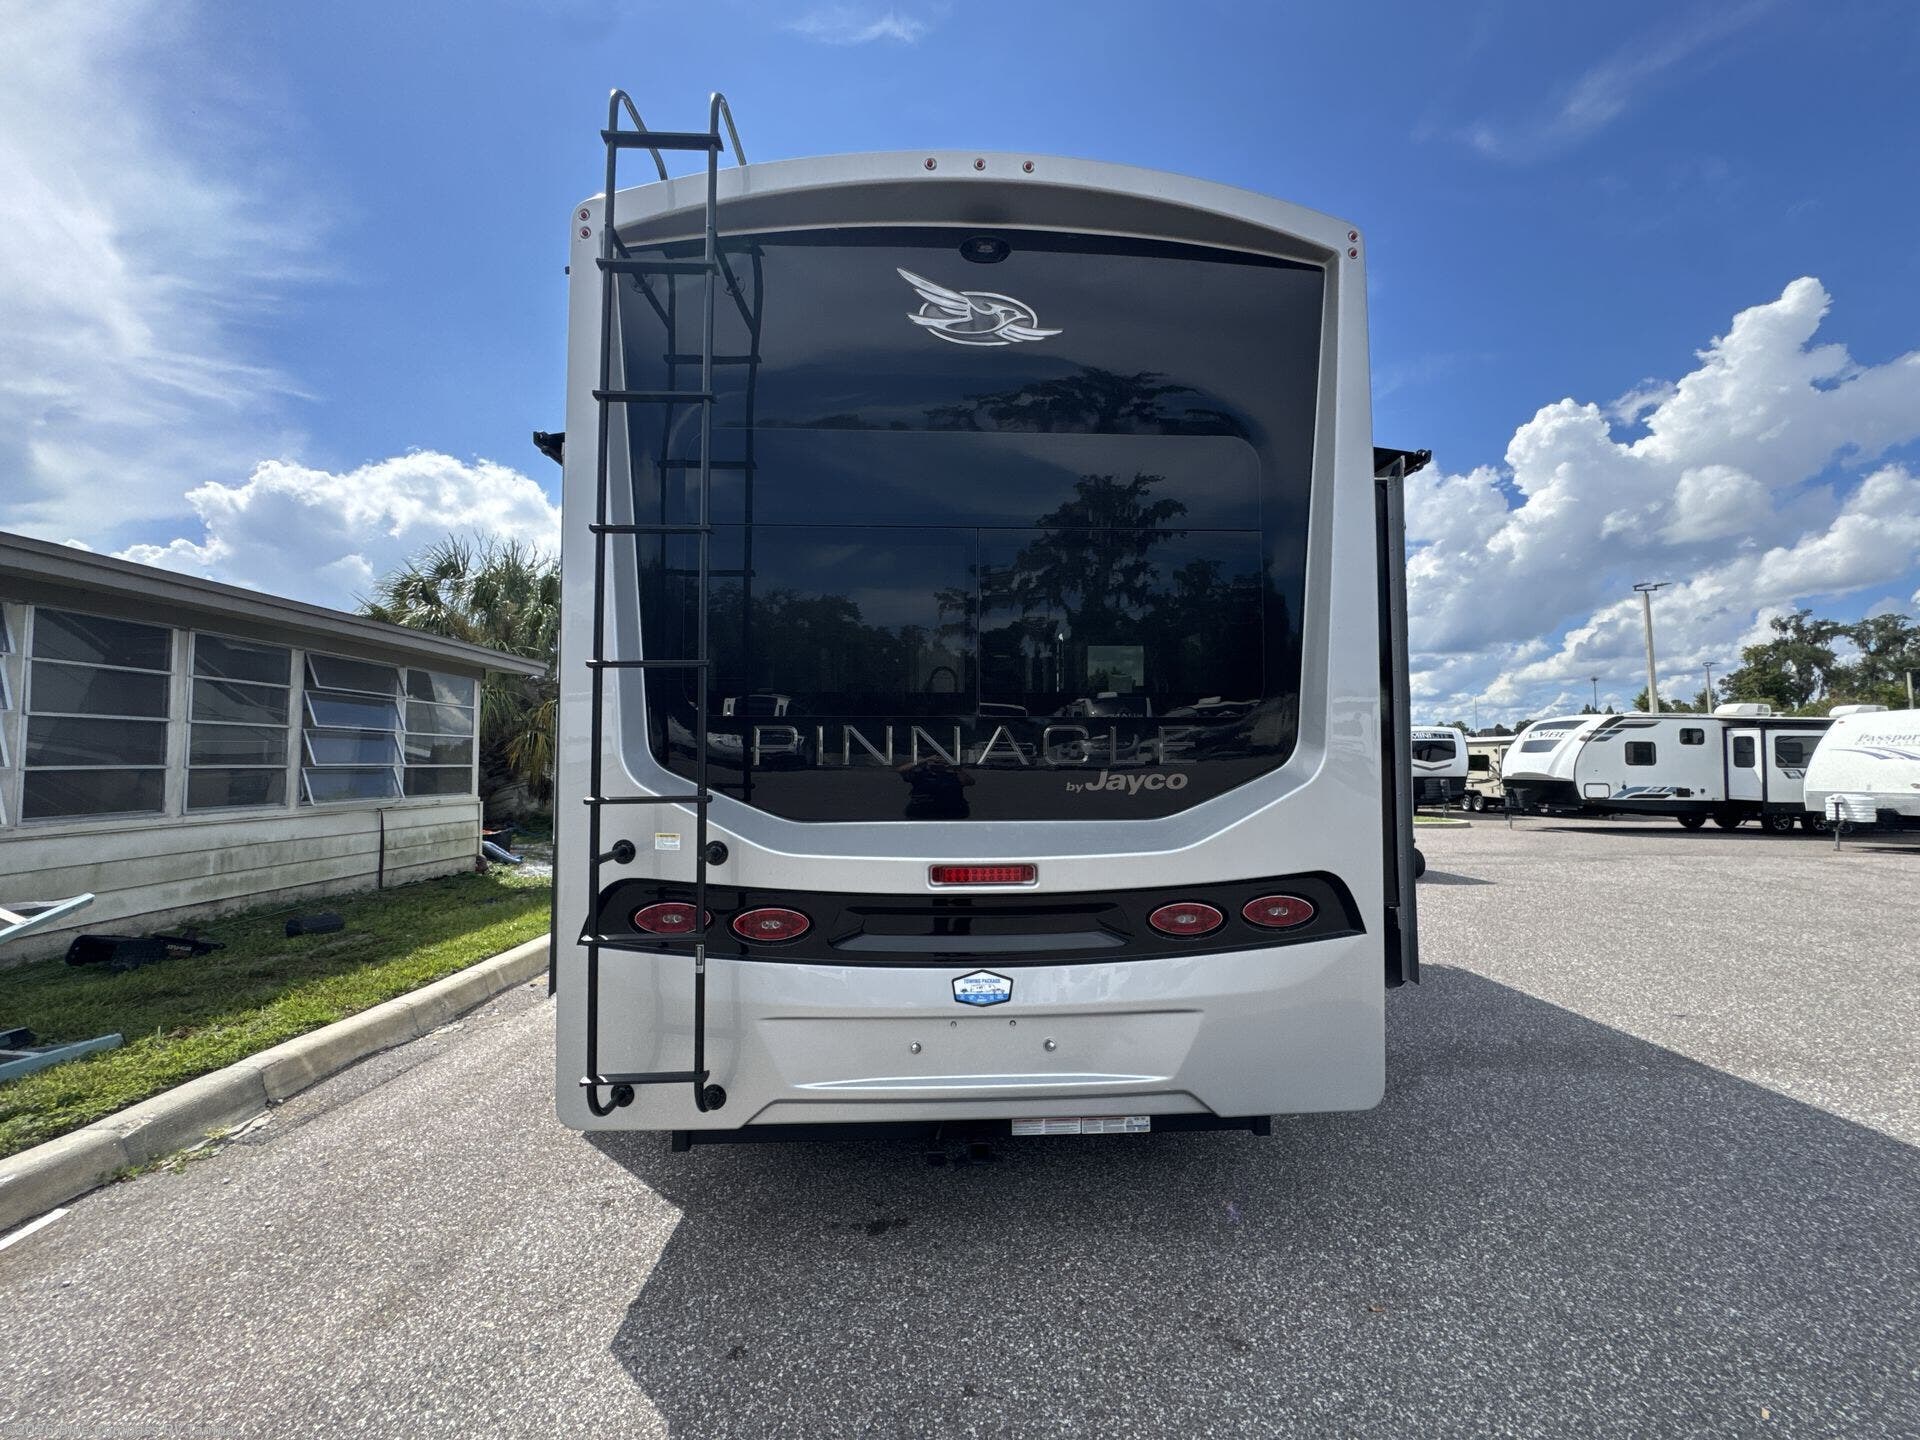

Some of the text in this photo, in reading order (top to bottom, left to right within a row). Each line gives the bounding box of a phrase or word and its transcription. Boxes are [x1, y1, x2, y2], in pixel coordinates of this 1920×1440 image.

[752, 725, 1197, 766] PINNACLE
[1857, 733, 1920, 743] Passpor
[1066, 769, 1188, 795] by Jayco
